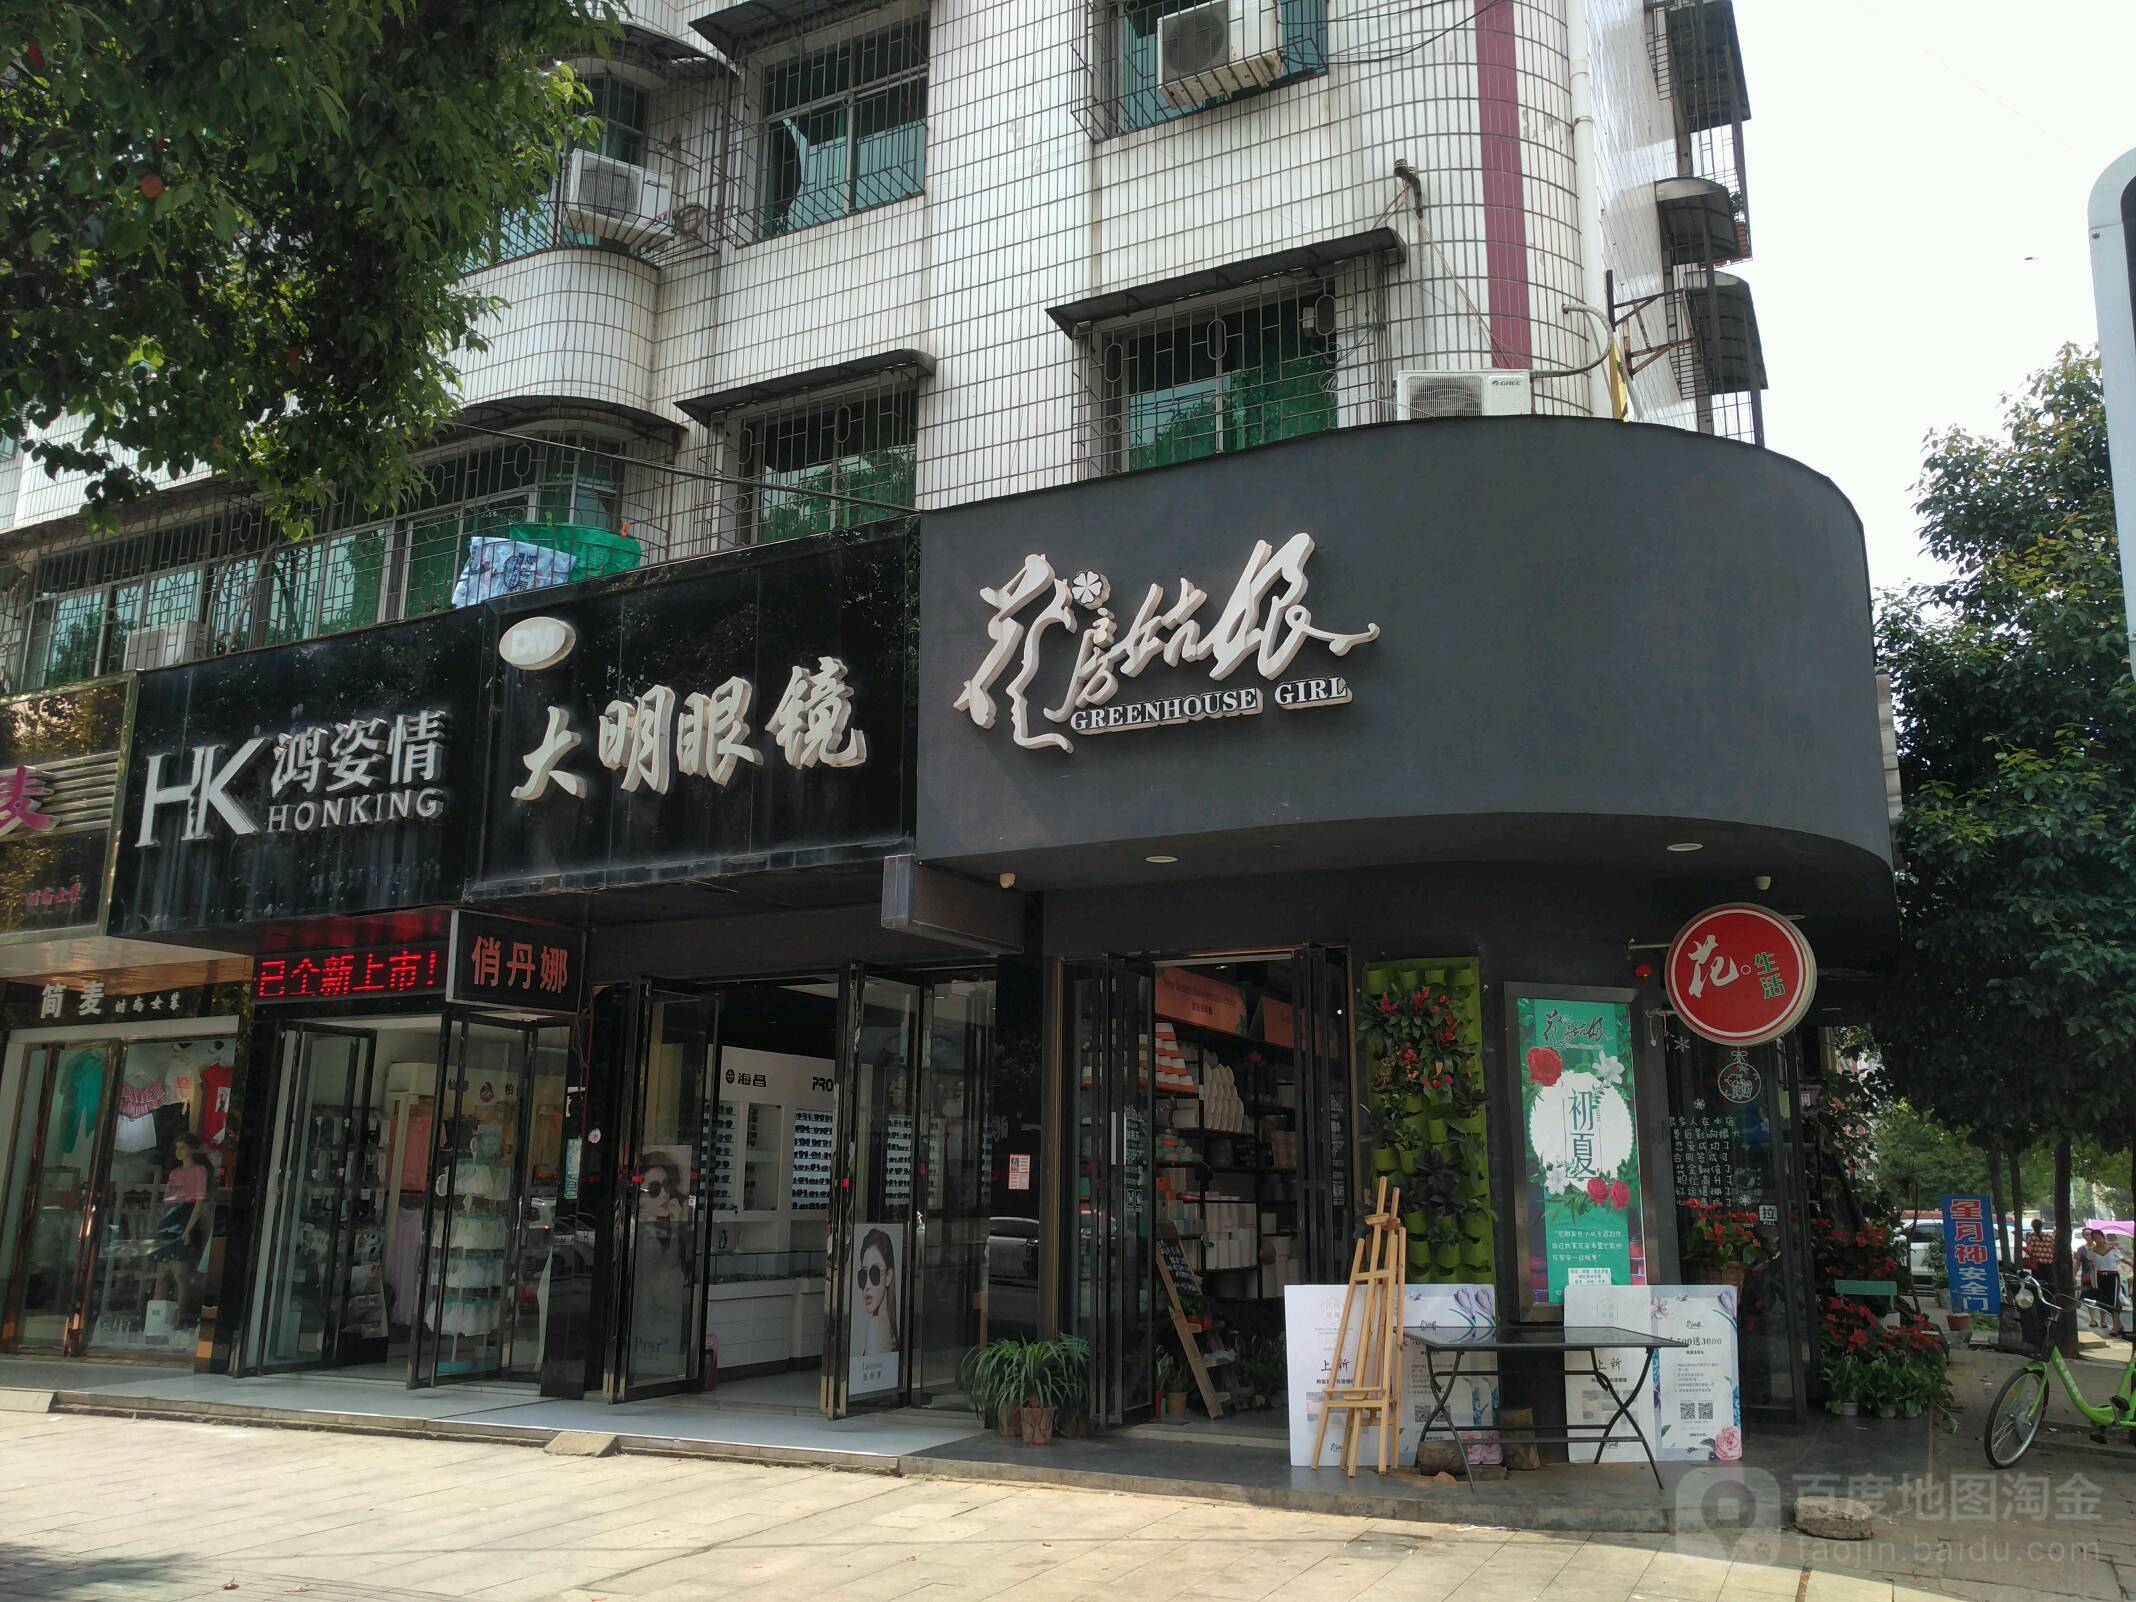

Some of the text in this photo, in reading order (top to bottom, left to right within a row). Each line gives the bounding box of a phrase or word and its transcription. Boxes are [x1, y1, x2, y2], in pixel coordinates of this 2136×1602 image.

[510, 656, 867, 801] 大明眼镜
[1070, 675, 1353, 734] GREENHOUSE GIRL
[270, 709, 446, 798] 鸿姿情
[134, 736, 273, 848] HK
[266, 787, 444, 834] HONKING
[470, 934, 568, 993] 俏丹娜
[1687, 934, 1740, 998] 花
[1754, 951, 1787, 1000] 生活
[40, 981, 105, 1020] 简麦
[737, 1072, 767, 1088] 海昌
[1567, 1087, 1597, 1178] 初夏
[1762, 1207, 1777, 1220] 拉
[1949, 1198, 1990, 1312] 星月神安全门
